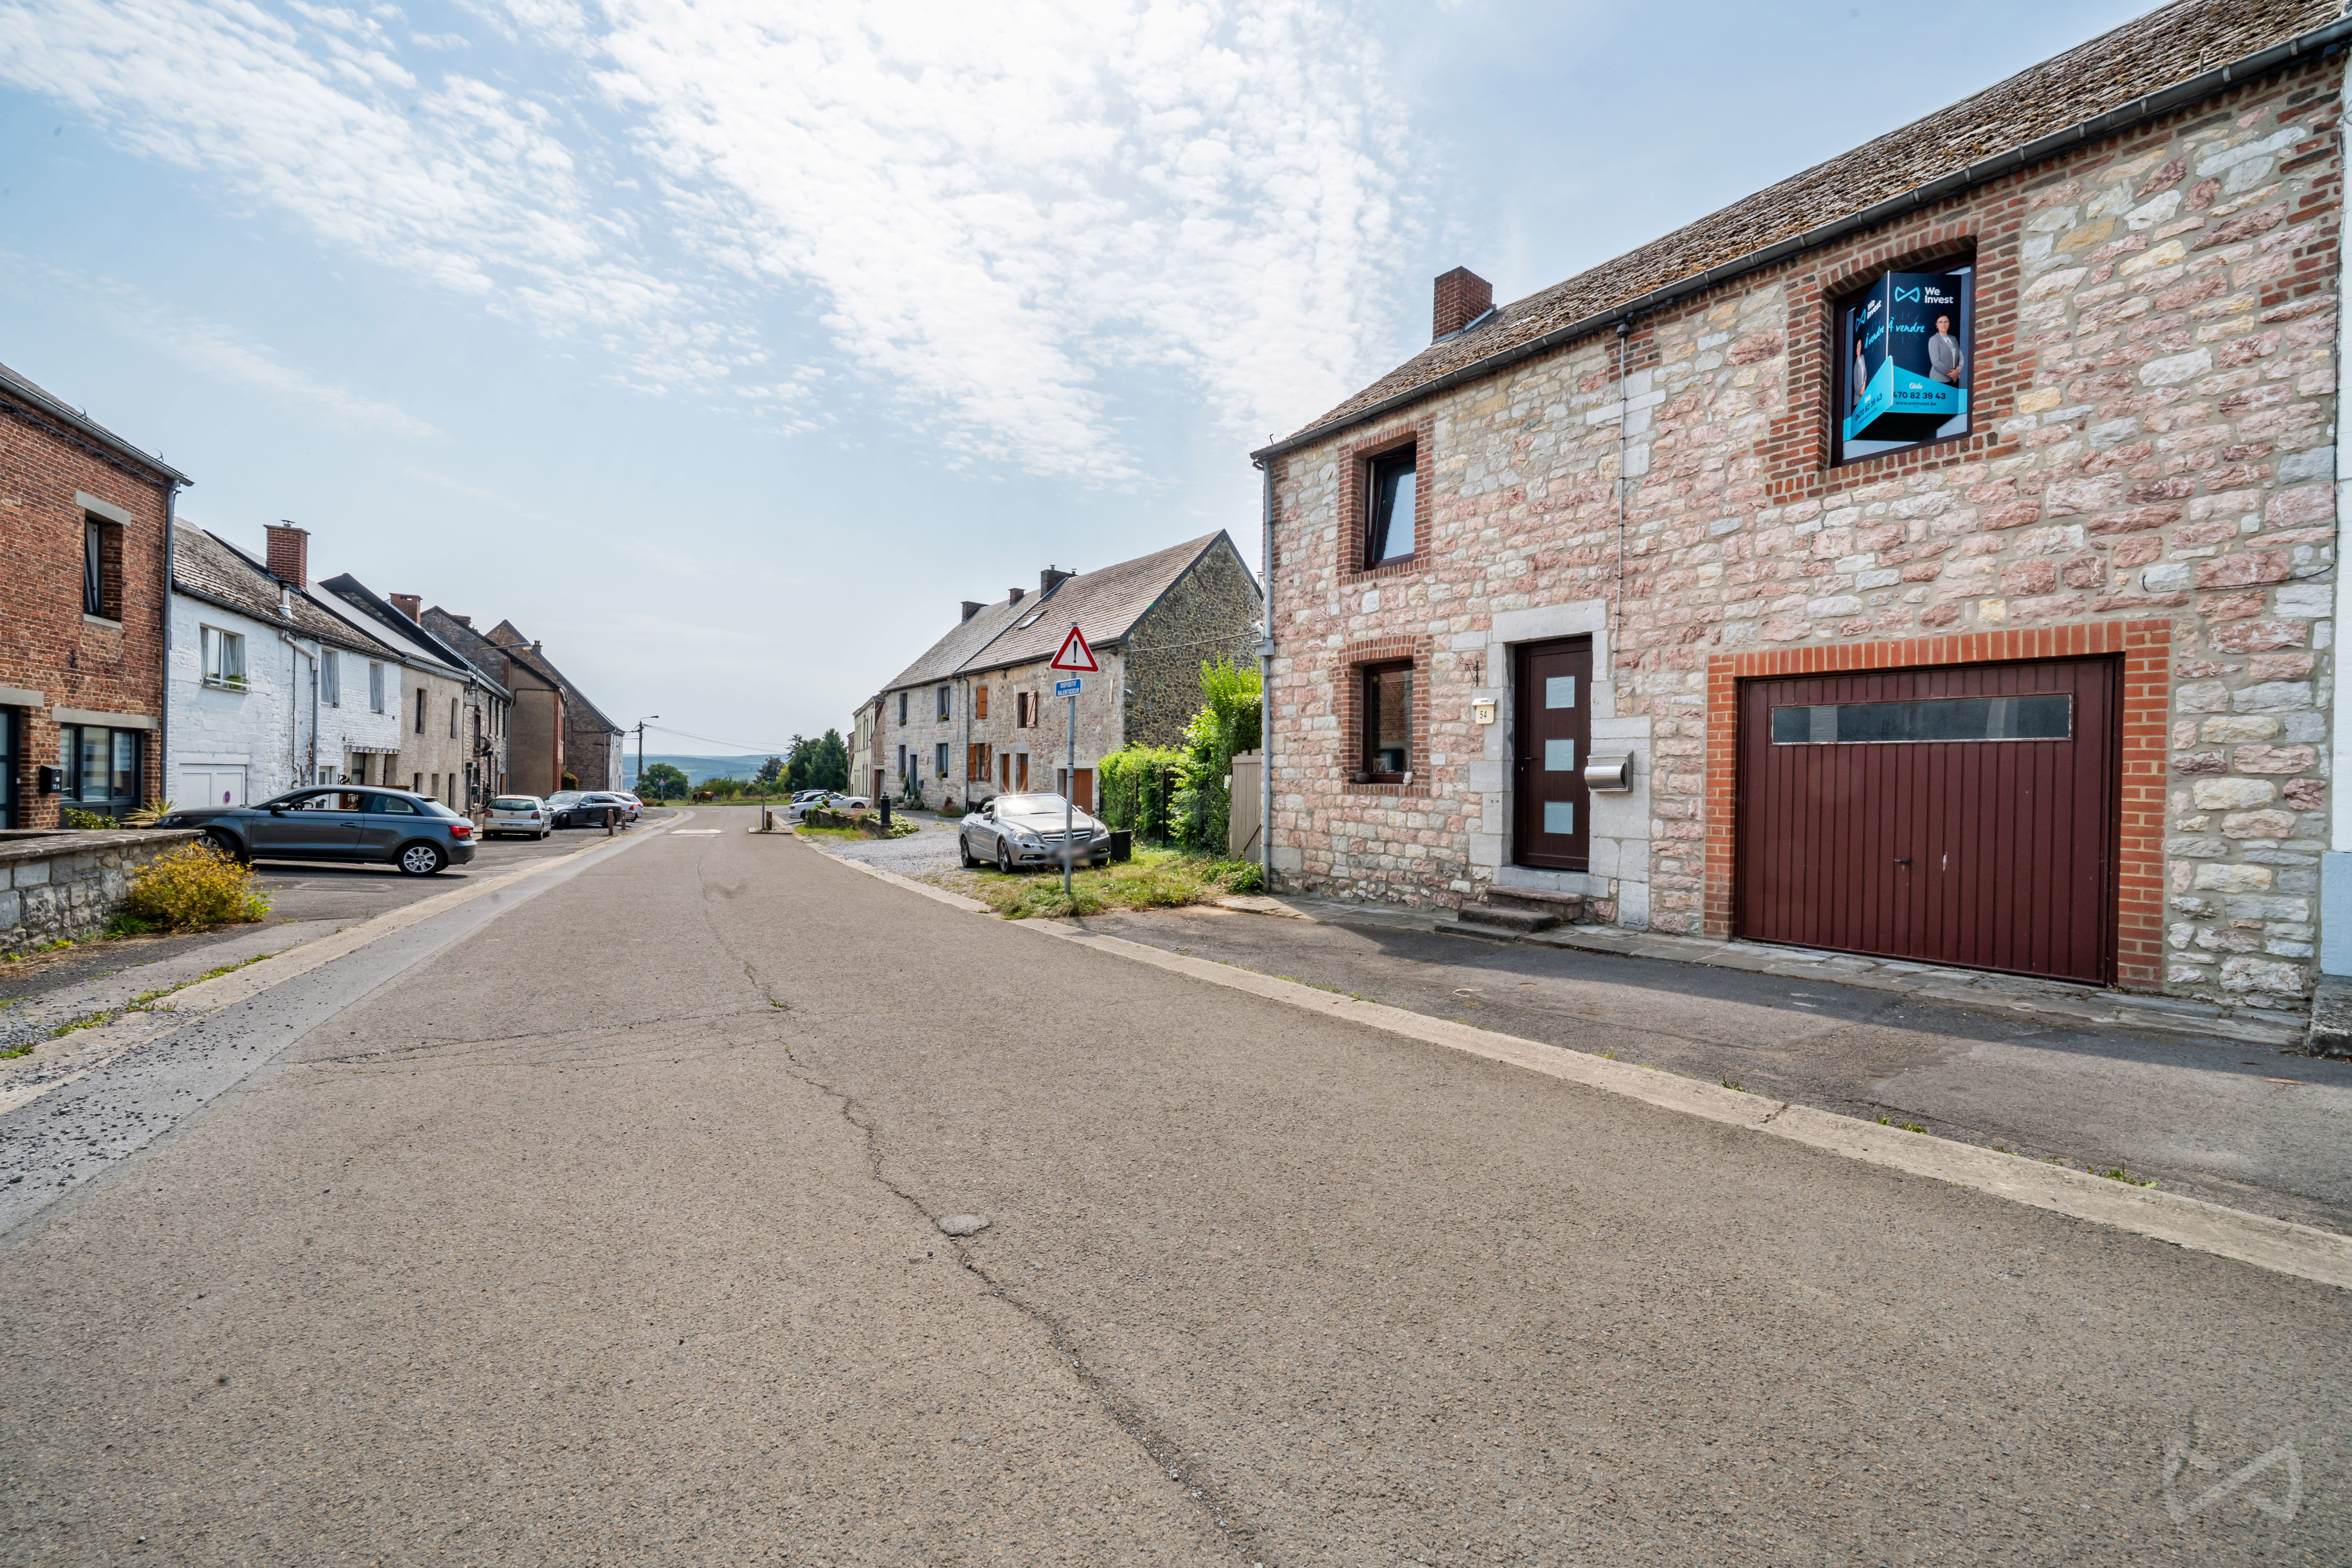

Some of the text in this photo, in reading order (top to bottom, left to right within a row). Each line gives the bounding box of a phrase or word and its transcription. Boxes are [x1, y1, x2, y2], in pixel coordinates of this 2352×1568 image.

[1925, 287, 1940, 295] We
[1867, 300, 1875, 311] We
[1925, 295, 1953, 303] Invest
[1867, 300, 1881, 319] Invest
[1888, 317, 1925, 333] À vendre
[1869, 325, 1884, 345] vendre
[1855, 408, 1864, 421] 0470
[1865, 403, 1870, 413] 82
[1871, 398, 1876, 408] 39
[1877, 393, 1882, 402] 43
[1480, 711, 1487, 719] 54
